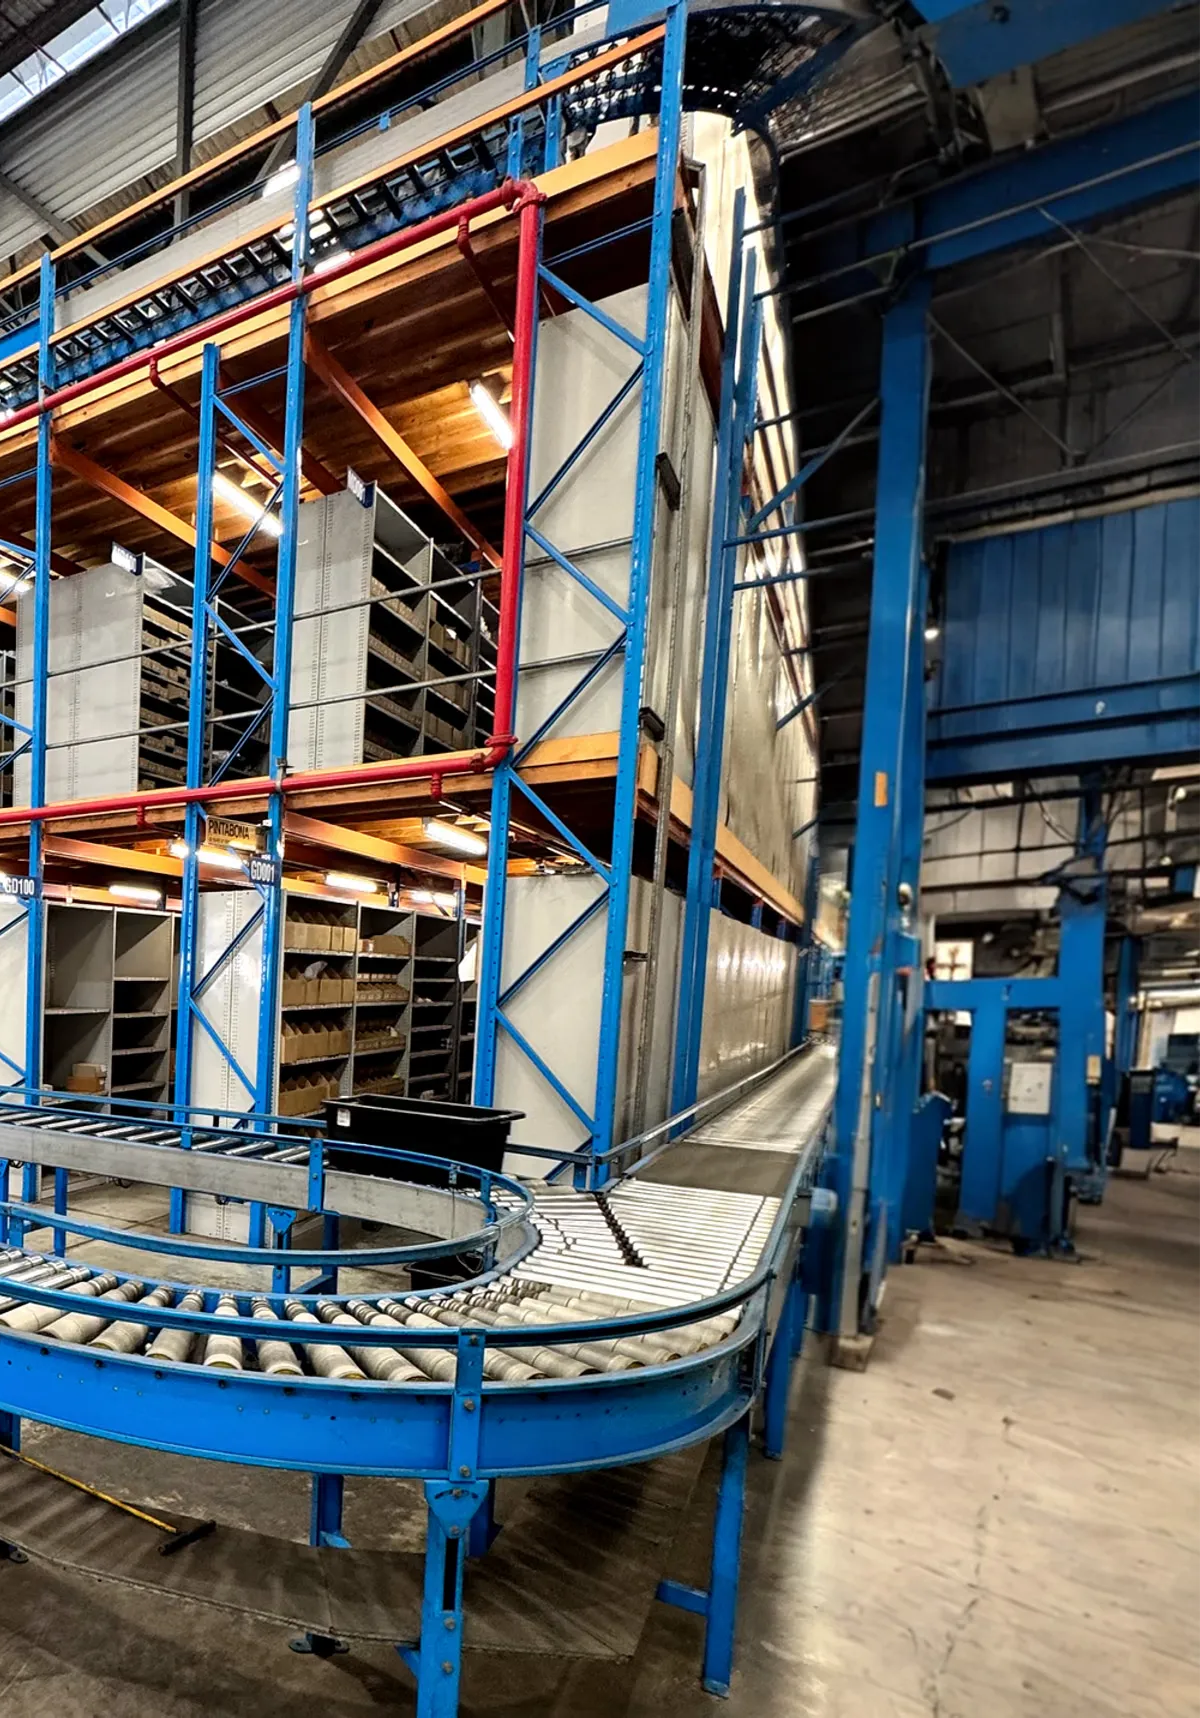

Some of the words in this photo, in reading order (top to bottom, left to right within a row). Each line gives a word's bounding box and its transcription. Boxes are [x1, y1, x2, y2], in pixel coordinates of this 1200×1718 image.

[208, 819, 250, 839] PINTABONA
[250, 860, 275, 882] GD001
[4, 876, 35, 896] GD100
